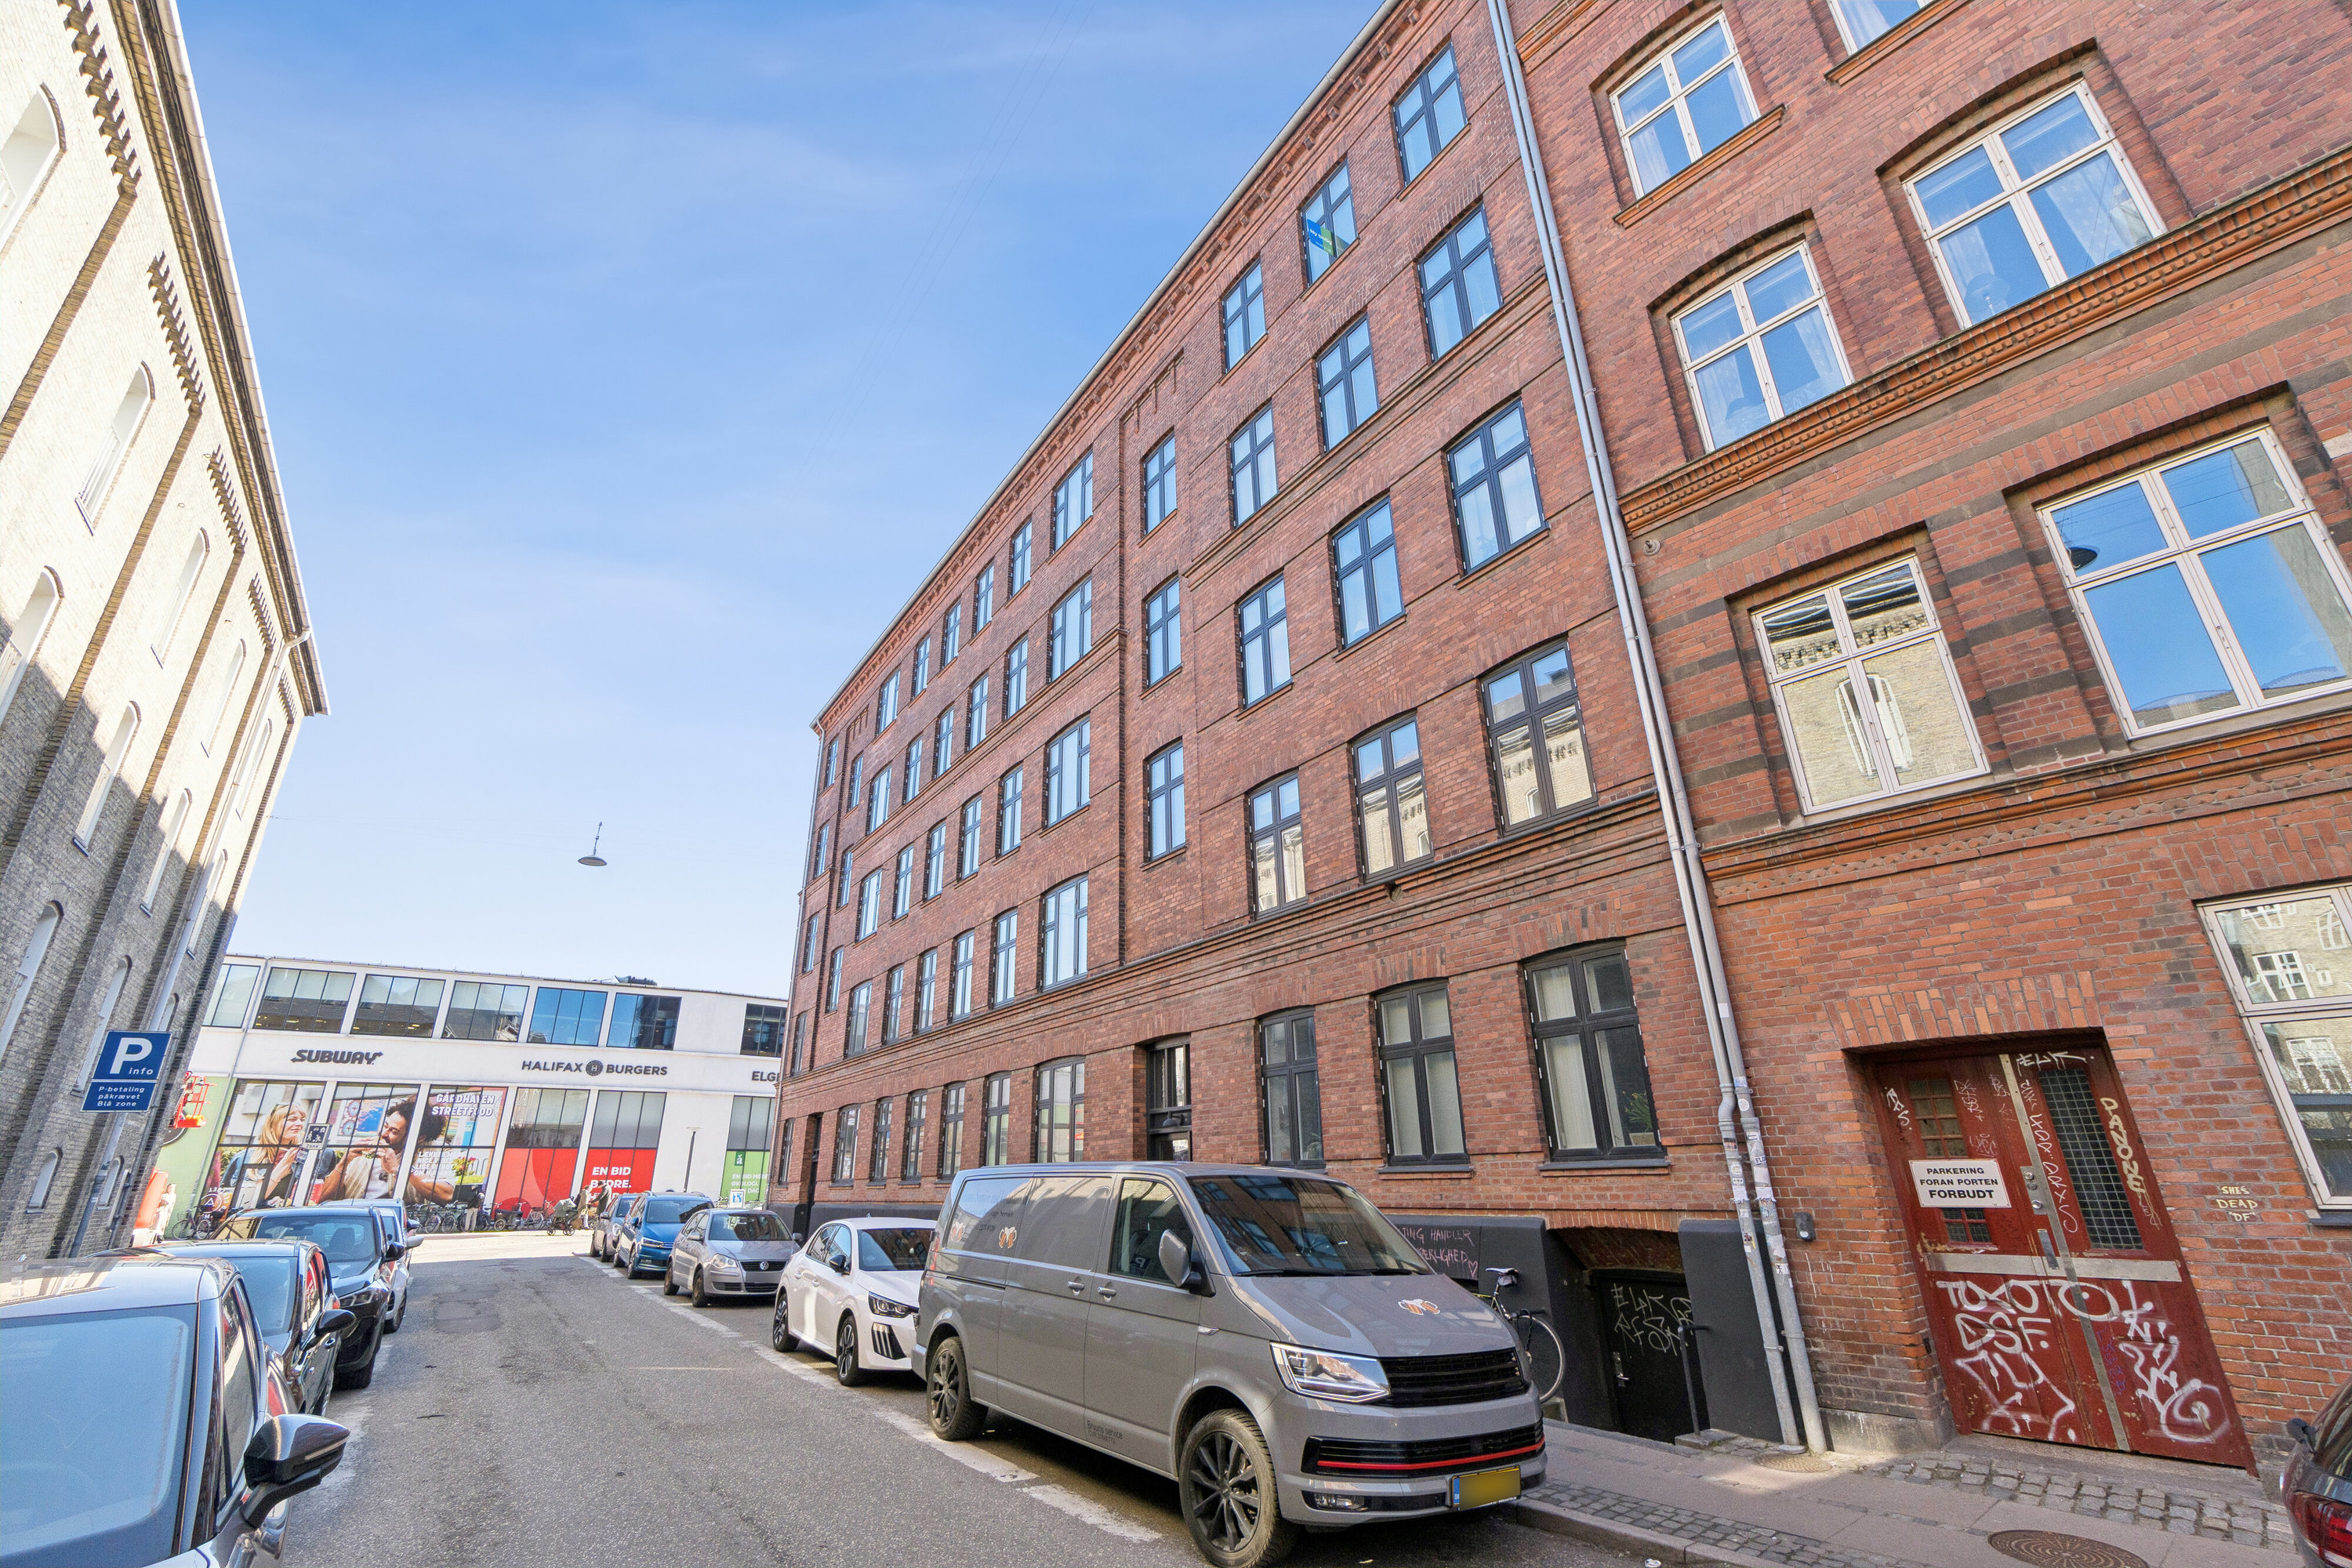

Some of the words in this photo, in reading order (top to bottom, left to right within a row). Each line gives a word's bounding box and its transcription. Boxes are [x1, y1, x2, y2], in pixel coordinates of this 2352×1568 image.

[110, 1037, 152, 1074] P
[291, 1049, 383, 1065] SUBWAY
[522, 1060, 583, 1073] HALIFAX
[606, 1064, 668, 1076] BURGERS
[592, 1167, 608, 1175] EN
[611, 1167, 631, 1175] BID
[1929, 1189, 1994, 1199] FORBUDT
[2216, 1199, 2258, 1210] DEAD
[1430, 1229, 1474, 1247] HANDLER
